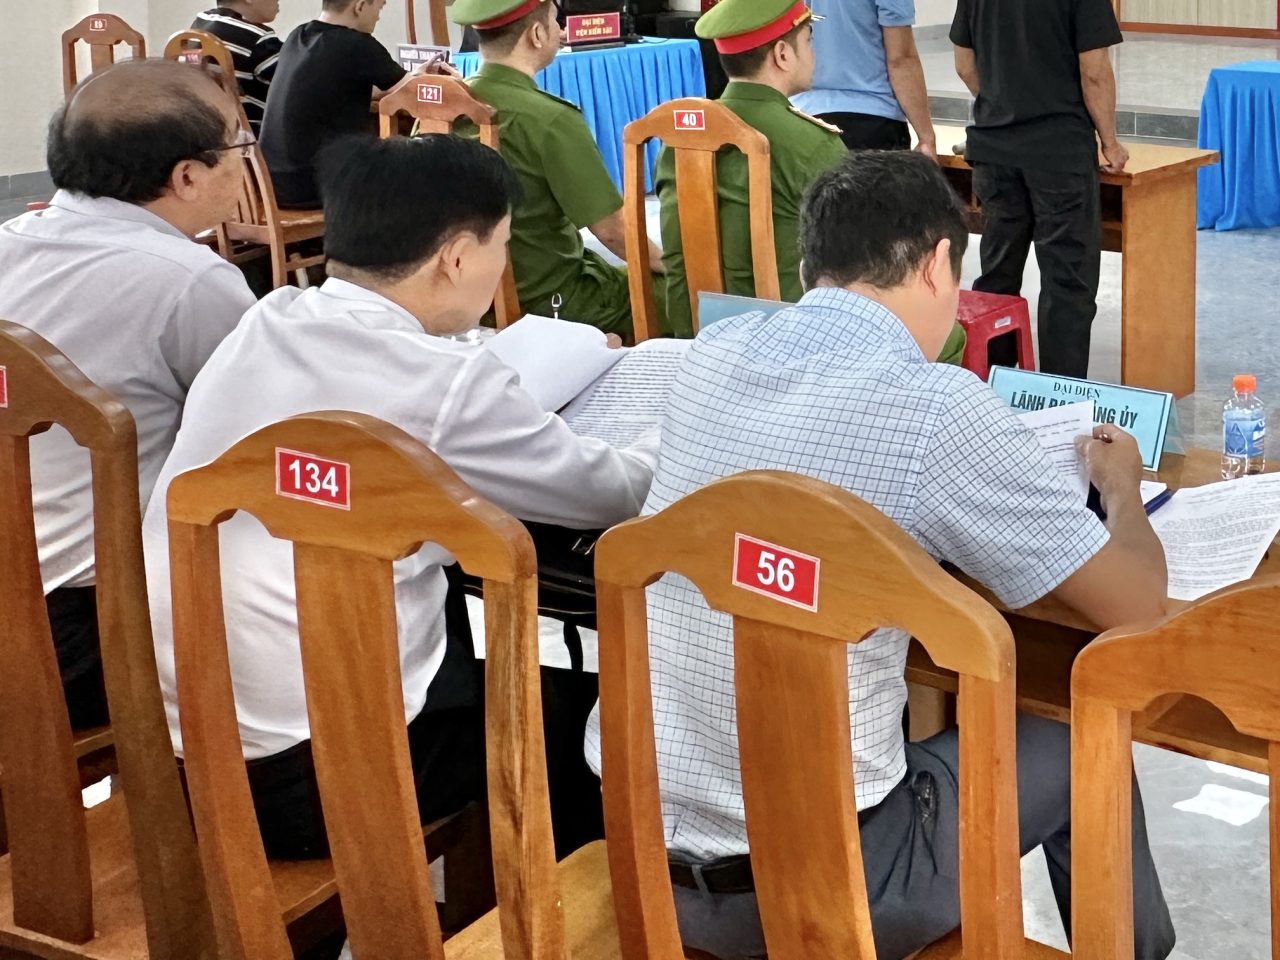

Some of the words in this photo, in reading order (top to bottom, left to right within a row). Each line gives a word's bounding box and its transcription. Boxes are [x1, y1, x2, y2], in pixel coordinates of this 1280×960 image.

[421, 87, 438, 100] 121
[682, 113, 697, 126] 40
[1010, 390, 1046, 411] LÃNH
[1119, 405, 1138, 429] ỦY
[288, 461, 339, 497] 134
[757, 550, 796, 593] 56
